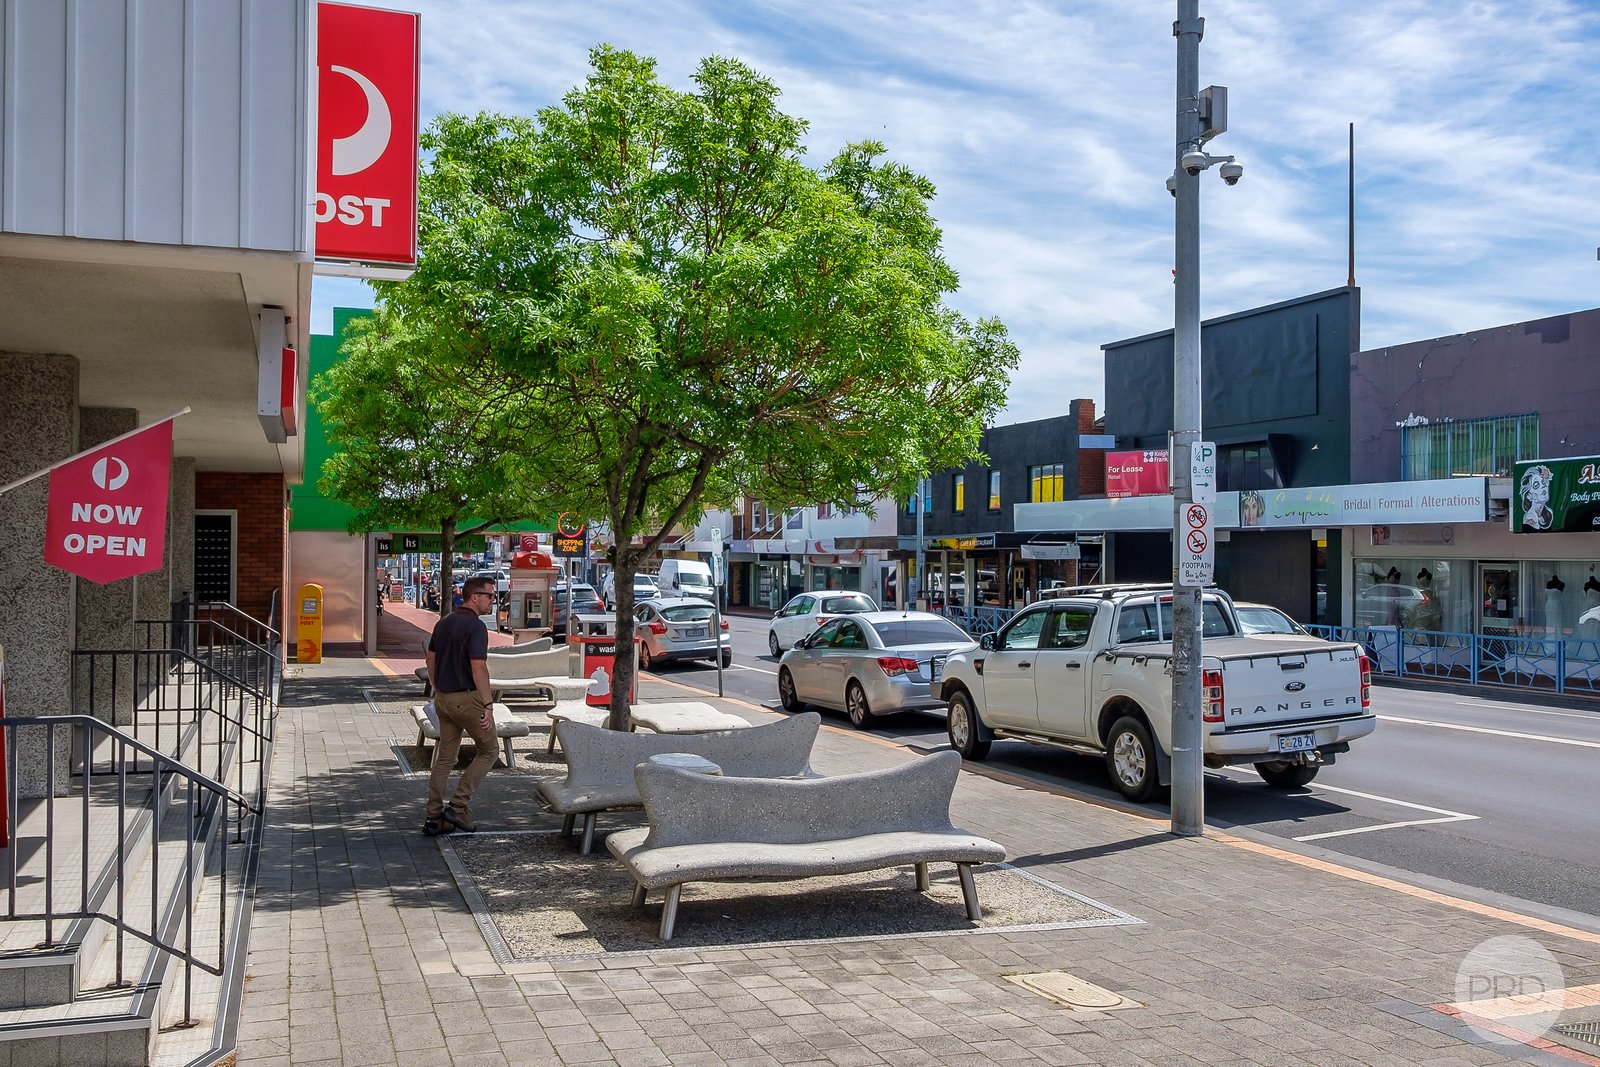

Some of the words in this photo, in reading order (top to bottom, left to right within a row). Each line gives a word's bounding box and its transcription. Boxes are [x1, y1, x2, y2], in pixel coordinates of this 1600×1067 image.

[1343, 499, 1371, 511] Bridal
[1378, 498, 1413, 510] Formal
[1421, 495, 1481, 508] Alterations
[1570, 491, 1590, 504] Body
[71, 502, 143, 526] NOW
[63, 533, 147, 557] OPEN
[380, 542, 389, 550] hs
[405, 537, 417, 549] hs
[1059, 548, 1070, 556] 73
[1230, 696, 1357, 715] RANGER
